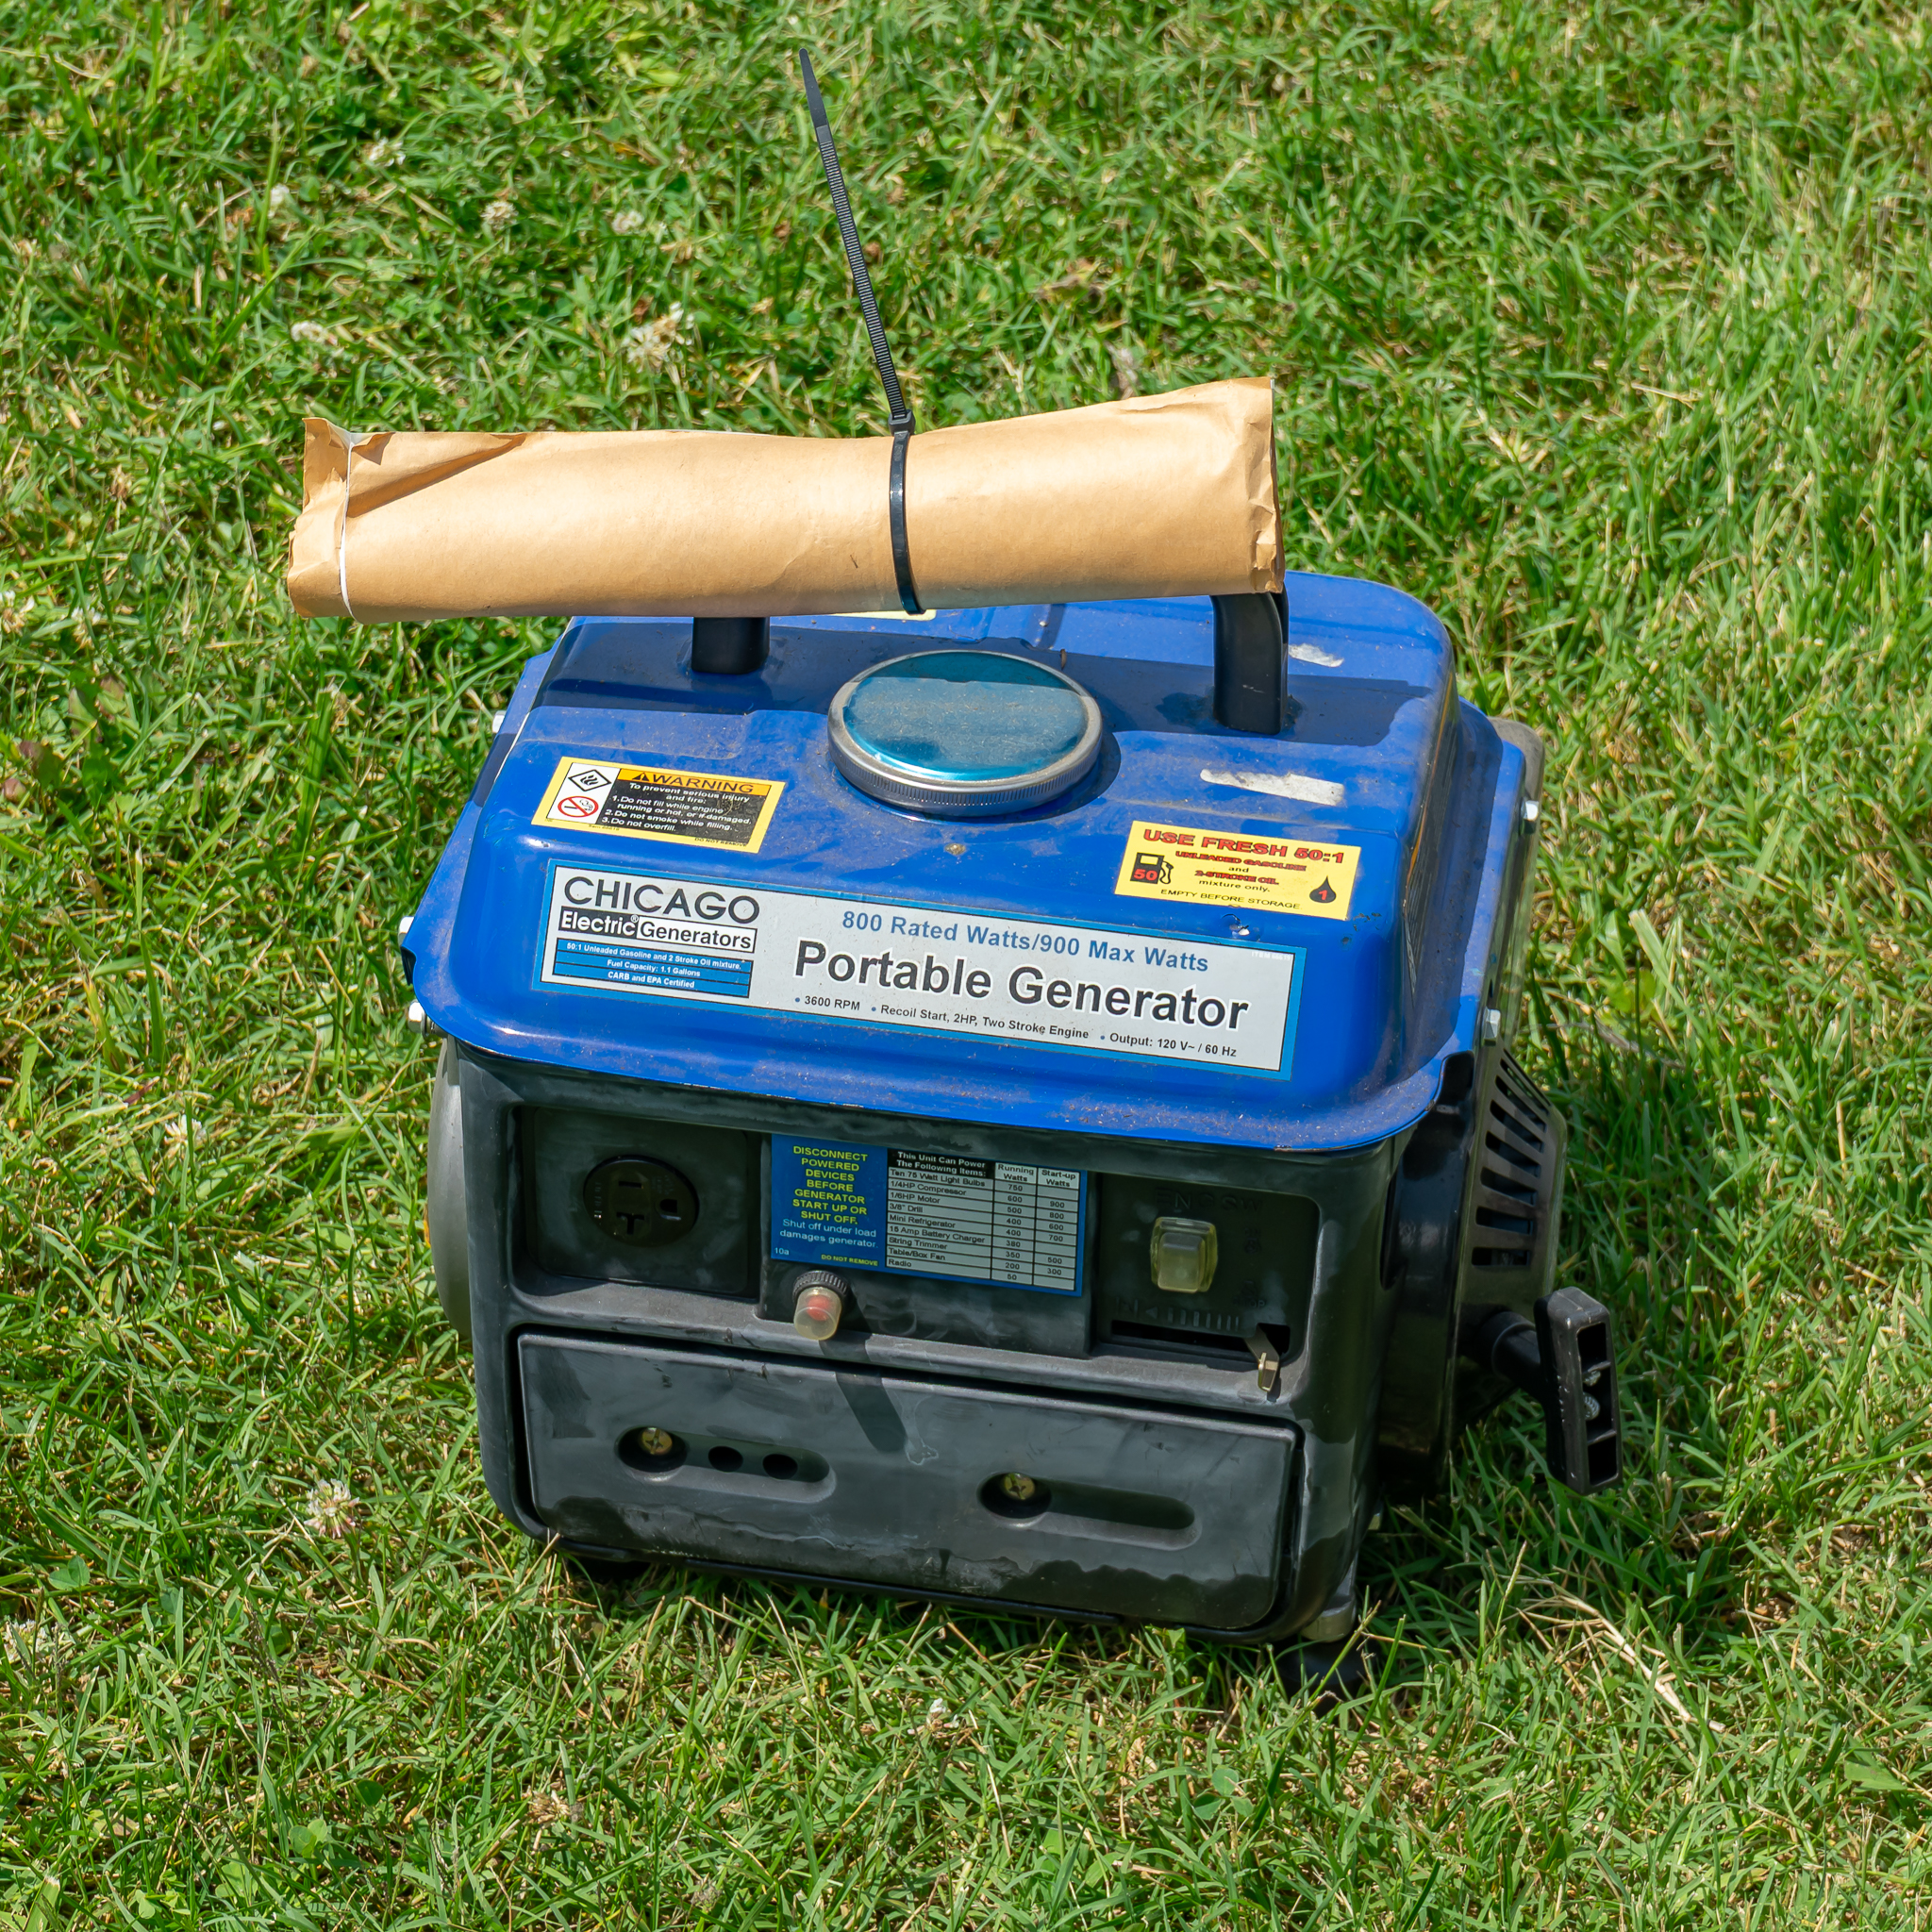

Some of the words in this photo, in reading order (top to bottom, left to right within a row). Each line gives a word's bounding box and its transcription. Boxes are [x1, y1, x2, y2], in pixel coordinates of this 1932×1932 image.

[653, 774, 754, 792] WARNING
[642, 785, 680, 794] prevent
[723, 793, 750, 803] injury
[617, 804, 652, 813] running
[706, 814, 751, 824] damaged,
[692, 806, 724, 814] engine
[644, 822, 676, 832] overfill.
[707, 822, 733, 831] filling.
[1143, 829, 1195, 846] USE
[1201, 837, 1288, 857] FRESH
[1294, 847, 1343, 863] 50:1
[1175, 851, 1241, 863] UNLEADED
[1243, 859, 1307, 872] GASOLINE
[1133, 869, 1158, 880] 50
[1194, 870, 1257, 882] 2-STROKE
[1199, 880, 1241, 889] mixture
[1245, 884, 1270, 892] only.
[564, 876, 759, 924] CHICAGO
[1201, 893, 1244, 902] BEFORE
[1319, 890, 1327, 900] 1
[640, 921, 751, 949] Generators
[842, 910, 882, 932] 800
[891, 916, 958, 941] Rated
[966, 924, 1080, 956] Watts/900
[1089, 941, 1135, 963] Max
[1144, 947, 1209, 972] Watts
[566, 942, 581, 951] 50:1
[584, 944, 618, 956] Unleaded
[620, 948, 652, 958] Gasoline
[675, 955, 698, 964] Stroke
[712, 959, 741, 970] mixture.
[608, 959, 622, 968] Fuel
[625, 961, 658, 973] Capacity:
[673, 967, 701, 976] Gallons
[608, 972, 630, 980] CARB
[632, 974, 645, 982] and
[647, 975, 662, 984] EPA
[664, 977, 694, 988] Certified
[795, 941, 991, 998] Portable
[1009, 966, 1249, 1029] Generator
[805, 995, 830, 1007] 3600
[834, 999, 860, 1010] RPM
[880, 1005, 917, 1018] Recoil
[920, 1009, 950, 1023] Start,
[954, 1013, 978, 1026] 2HP,
[983, 1017, 1005, 1028] Two
[1008, 1020, 1045, 1034] Stroke
[1049, 1025, 1090, 1039] Engine
[1110, 1032, 1153, 1048] Output:
[1157, 1039, 1176, 1049] 120
[1206, 1044, 1218, 1055] 60
[1222, 1046, 1238, 1057] Hz
[793, 1146, 868, 1161] DISCONNECT
[898, 1151, 916, 1159] This
[958, 1159, 986, 1168] Power
[802, 1158, 859, 1171] POWERED
[915, 1162, 957, 1174] Following
[960, 1168, 987, 1176] Items:
[997, 1164, 1034, 1175] Running
[806, 1169, 855, 1181] DEVICES
[891, 1169, 905, 1177] Ten
[920, 1173, 938, 1181] Watt
[941, 1175, 960, 1185] Light
[963, 1178, 985, 1187] Bulbs
[1004, 1174, 1028, 1182] Watts
[1041, 1170, 1076, 1180] Start-up
[807, 1179, 854, 1192] BEFORE
[918, 1184, 967, 1195] Compressor
[1046, 1178, 1071, 1187] Watts
[794, 1189, 865, 1204] GENERATOR
[918, 1195, 941, 1204] Motor
[792, 1199, 828, 1209] START
[832, 1204, 847, 1212] UP
[850, 1207, 867, 1215] OR
[801, 1210, 831, 1221] SHUT
[834, 1215, 858, 1224] OFF.
[908, 1217, 956, 1228] Refrigerator
[783, 1219, 806, 1229] Shut
[824, 1224, 853, 1234] under
[856, 1227, 876, 1238] load
[901, 1227, 920, 1236] Amp
[922, 1229, 951, 1240] Battery
[953, 1233, 986, 1243] Charger
[780, 1229, 825, 1241] damages
[828, 1236, 878, 1248] generator.
[889, 1237, 912, 1246] String
[914, 1240, 948, 1249] Trimmer
[774, 1247, 789, 1256] 10a
[889, 1247, 927, 1258] Table/Box
[849, 1257, 878, 1266] REMOVE
[889, 1258, 912, 1267] Radio
